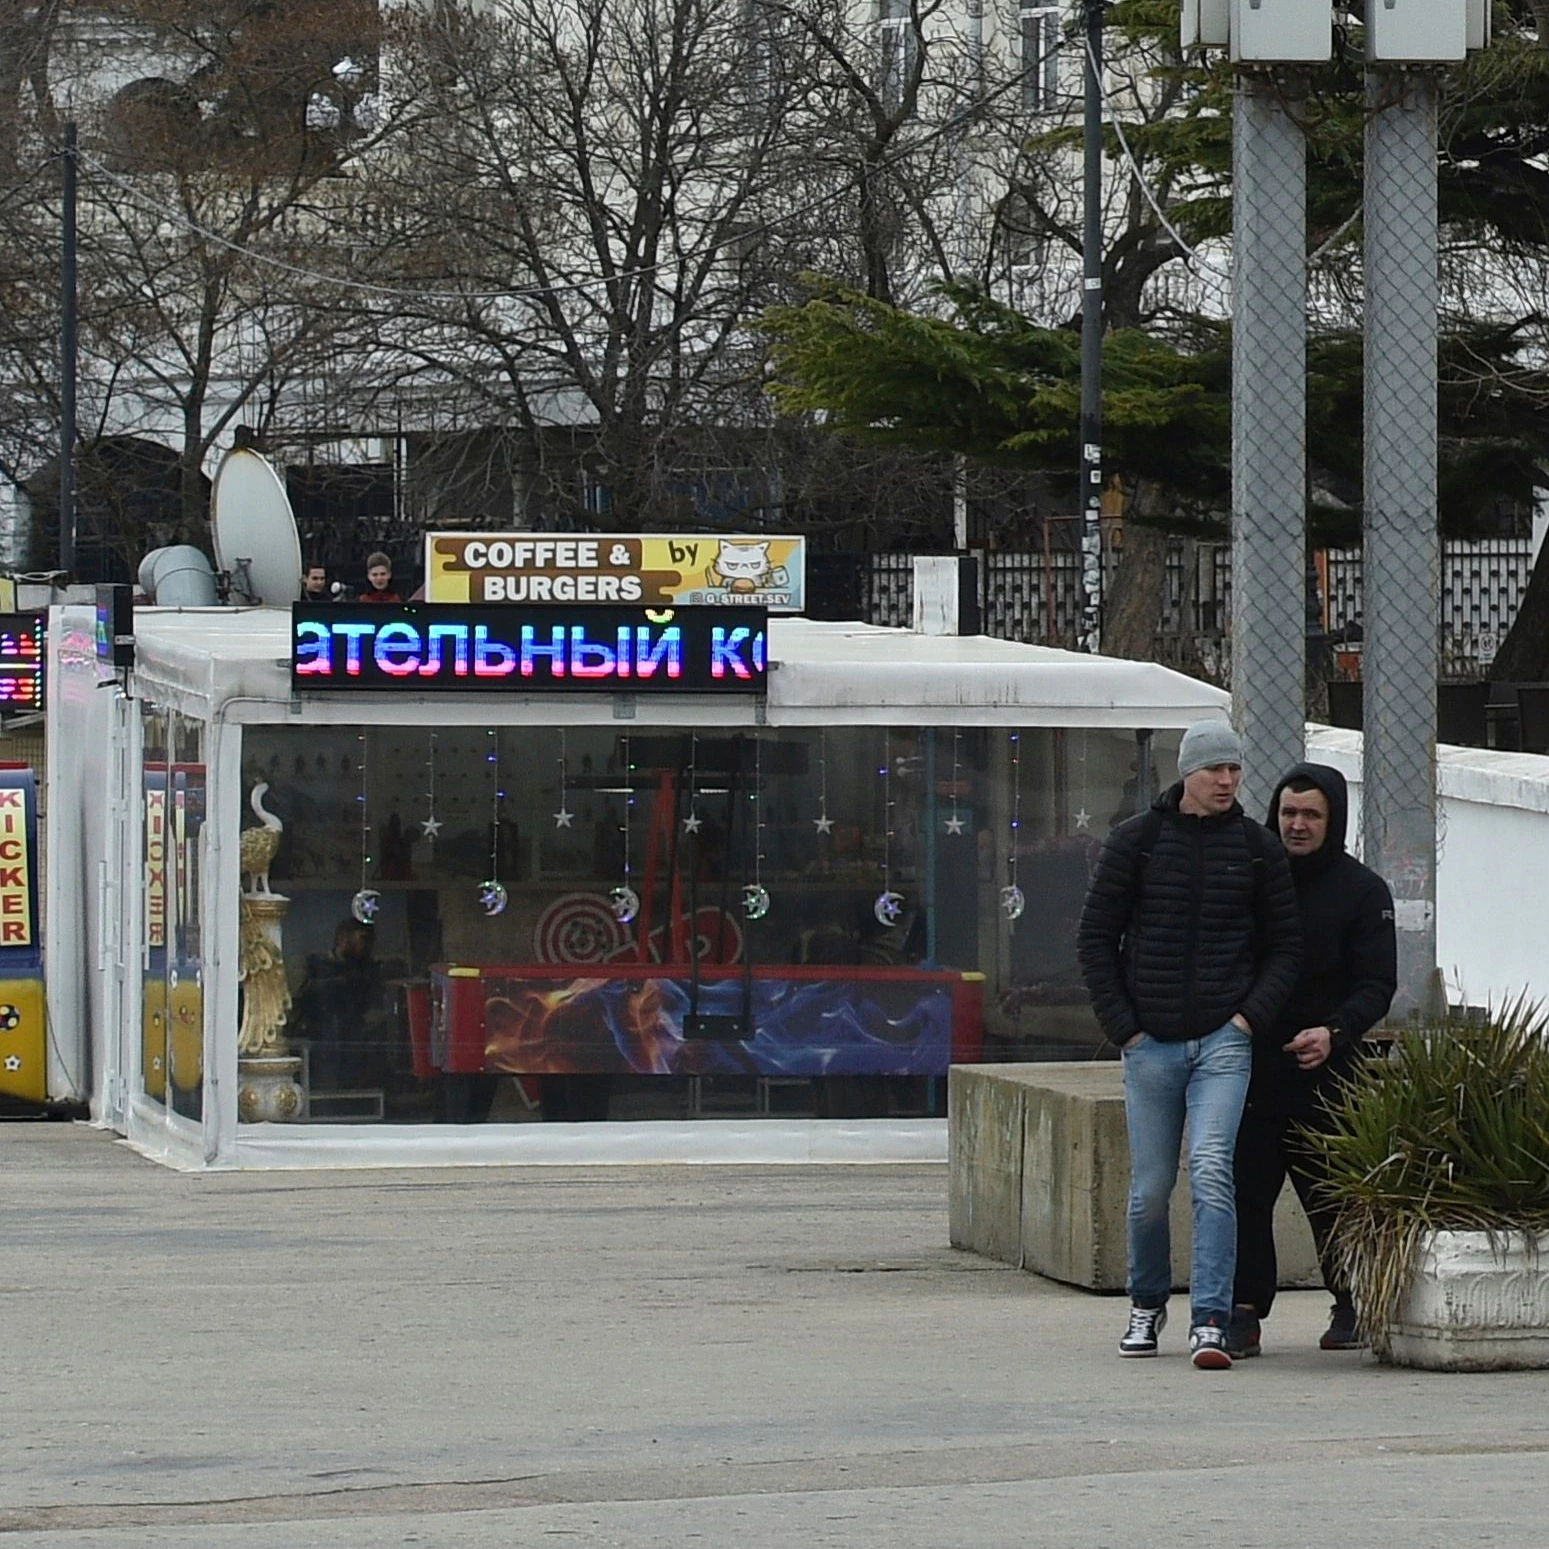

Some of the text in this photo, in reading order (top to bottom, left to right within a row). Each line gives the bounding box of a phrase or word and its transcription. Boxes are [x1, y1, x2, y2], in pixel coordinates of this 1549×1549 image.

[464, 541, 631, 567] COFFEE &
[669, 540, 699, 566] by
[484, 575, 642, 602] BURGERS
